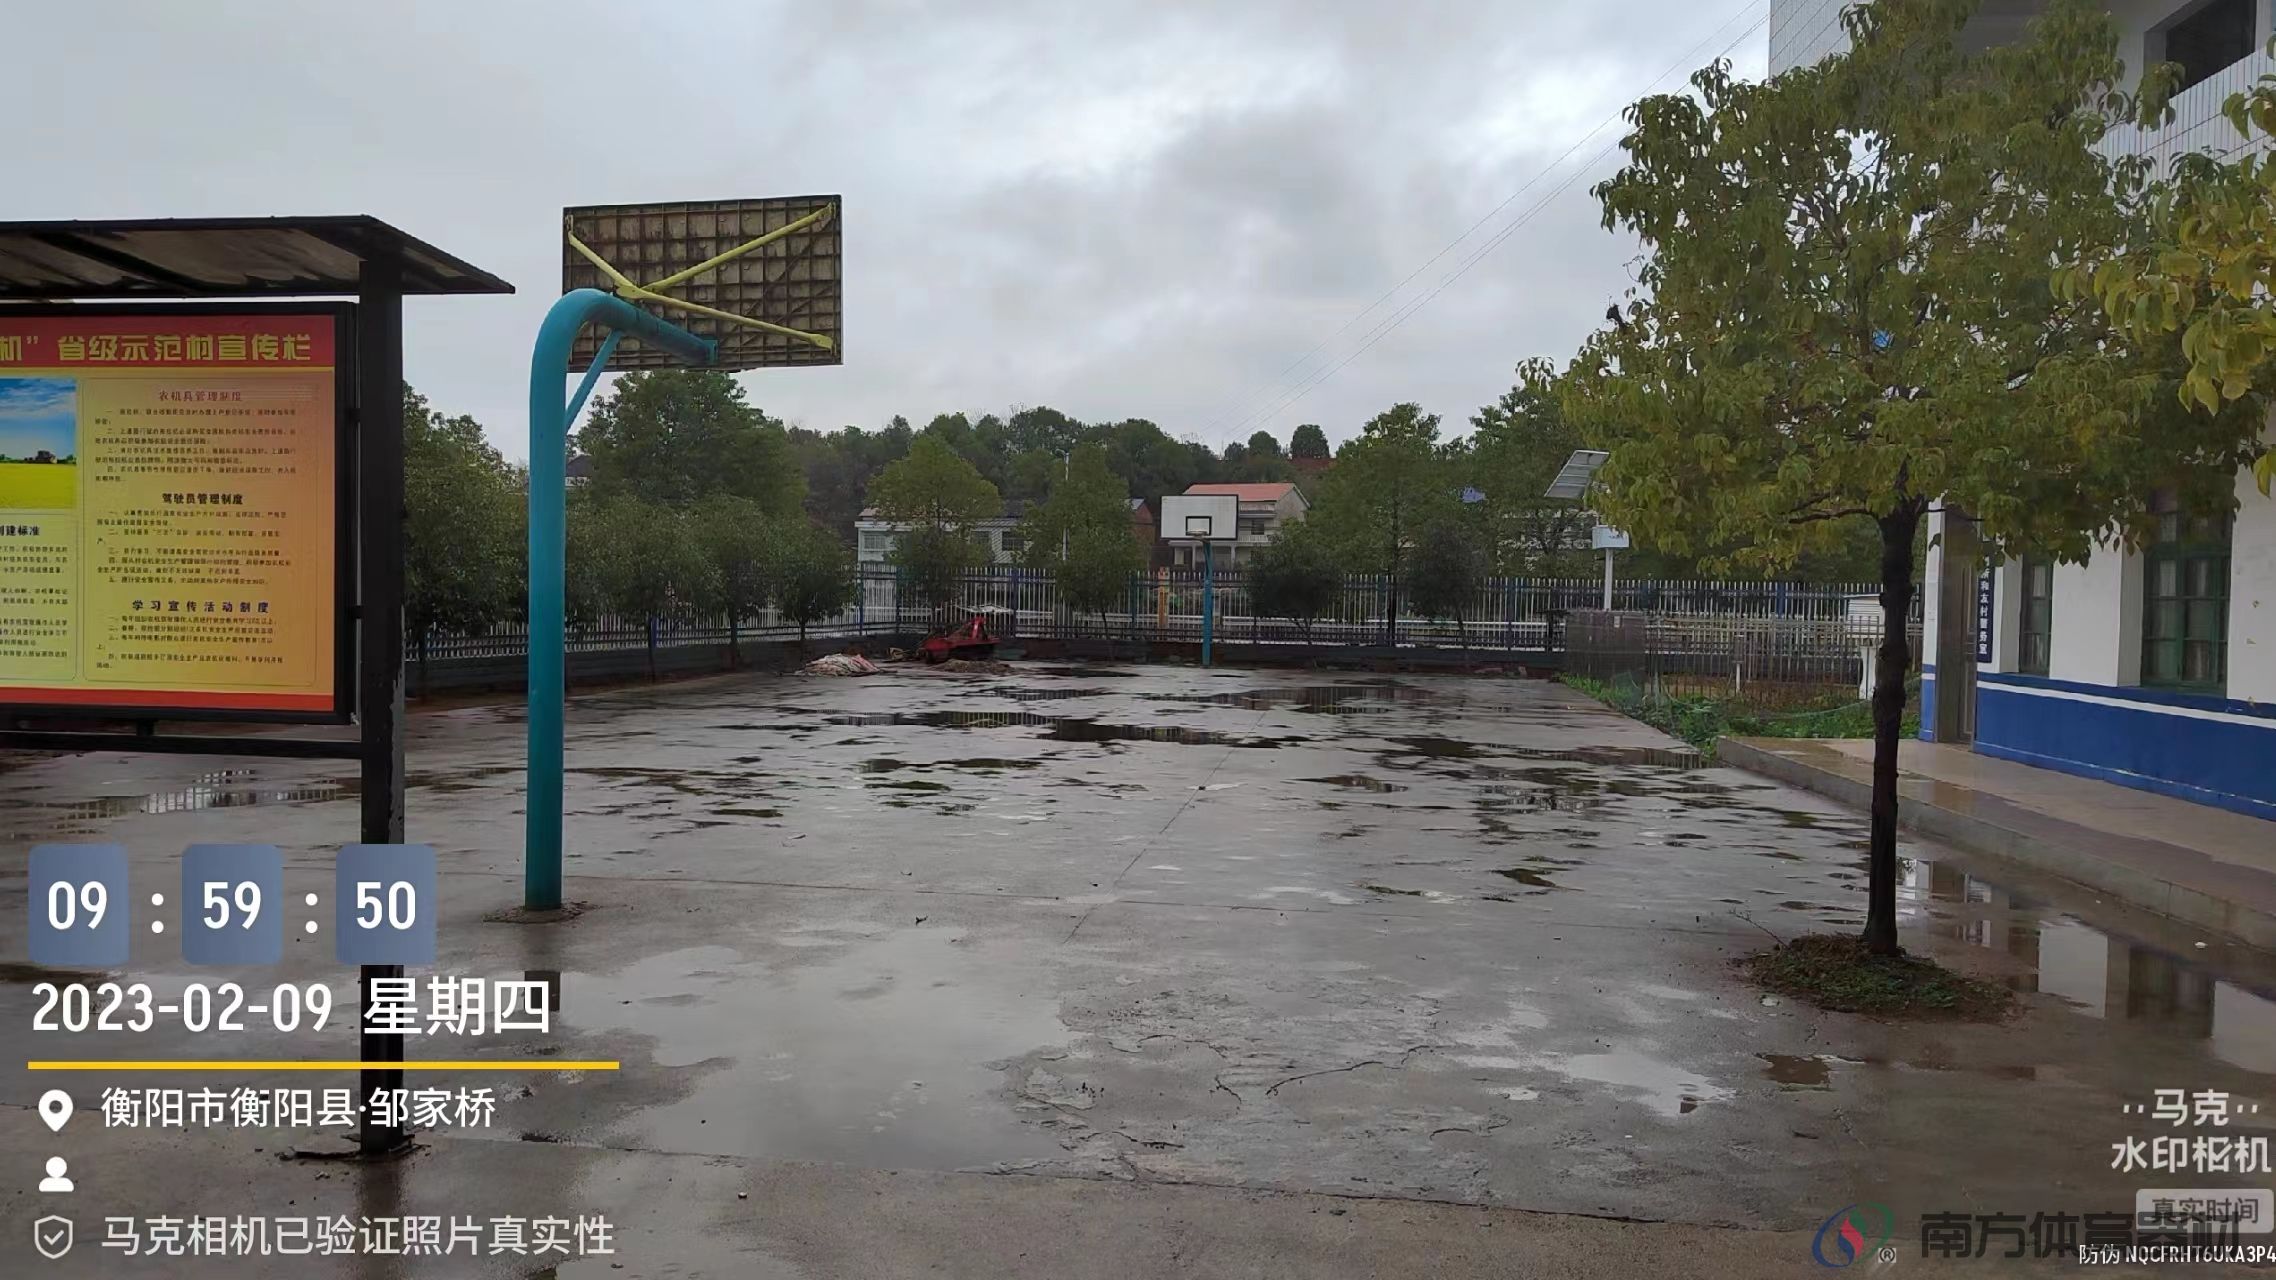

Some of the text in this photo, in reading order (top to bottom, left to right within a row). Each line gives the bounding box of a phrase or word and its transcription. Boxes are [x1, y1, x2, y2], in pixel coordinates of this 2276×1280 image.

[162, 493, 244, 505] 驾驶员管理制度
[132, 600, 270, 613] 学习宣传活动制度
